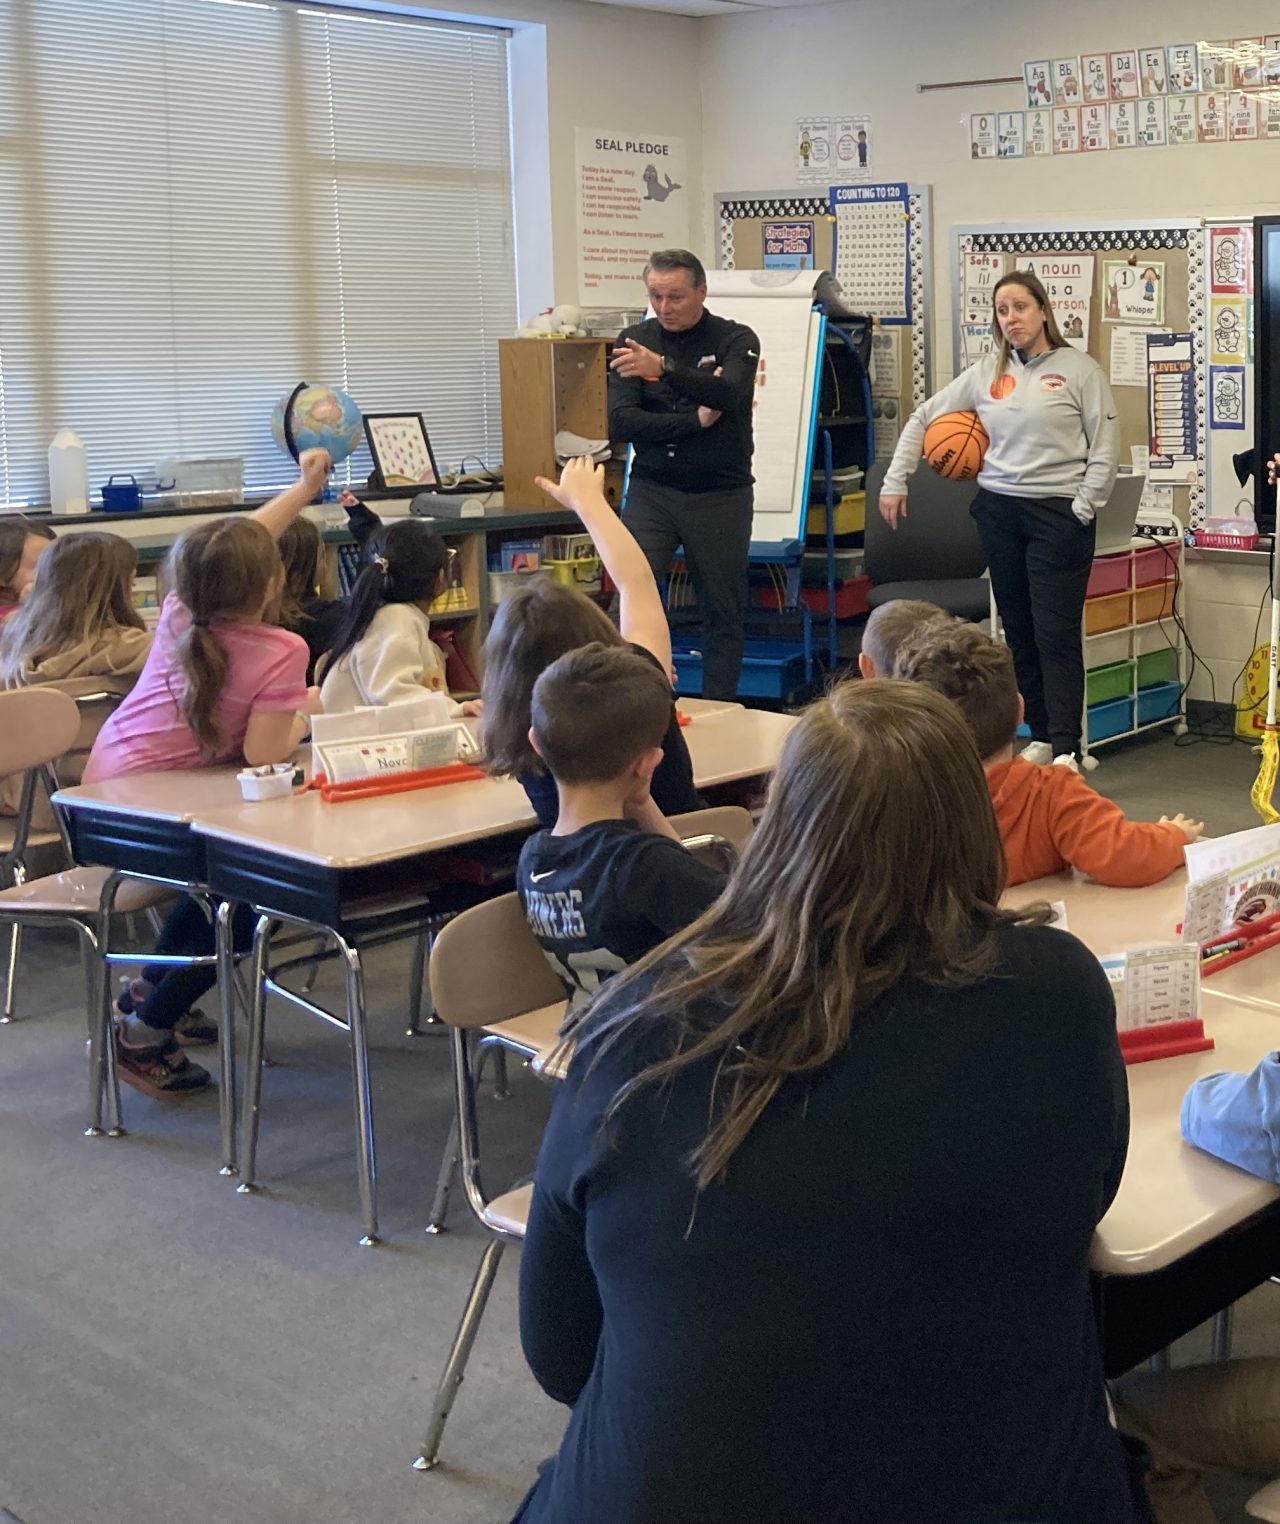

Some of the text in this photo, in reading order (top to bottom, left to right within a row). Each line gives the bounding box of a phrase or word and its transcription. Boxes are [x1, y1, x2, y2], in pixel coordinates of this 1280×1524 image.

[1117, 57, 1130, 70] Dd
[1146, 54, 1158, 66] Ee
[1059, 64, 1072, 76] Bb
[1089, 61, 1101, 72] Cc
[1032, 68, 1045, 80] Aa
[1148, 101, 1155, 114] 6
[1180, 99, 1186, 112] 7
[1208, 97, 1215, 110] 8
[1240, 96, 1247, 108] 9
[1063, 110, 1070, 122] 3
[1091, 108, 1098, 120] 4
[1119, 104, 1125, 116] 5
[980, 117, 987, 130] 0
[1009, 115, 1013, 128] 1
[1034, 112, 1041, 125] 2
[595, 139, 669, 156] SEAL PLEDGE
[836, 187, 900, 199] COUNTING TO 120
[766, 225, 810, 240] Strategies
[767, 240, 807, 253] for Math
[970, 256, 998, 268] Soft g
[1042, 263, 1080, 275] noun
[1122, 270, 1127, 285] 1
[1047, 282, 1072, 295] is a
[1051, 300, 1087, 311] erson,
[1126, 304, 1154, 315] Whisper
[967, 326, 992, 336] Hard
[1155, 362, 1191, 372] LEVEL UP
[932, 448, 957, 475] ilson
